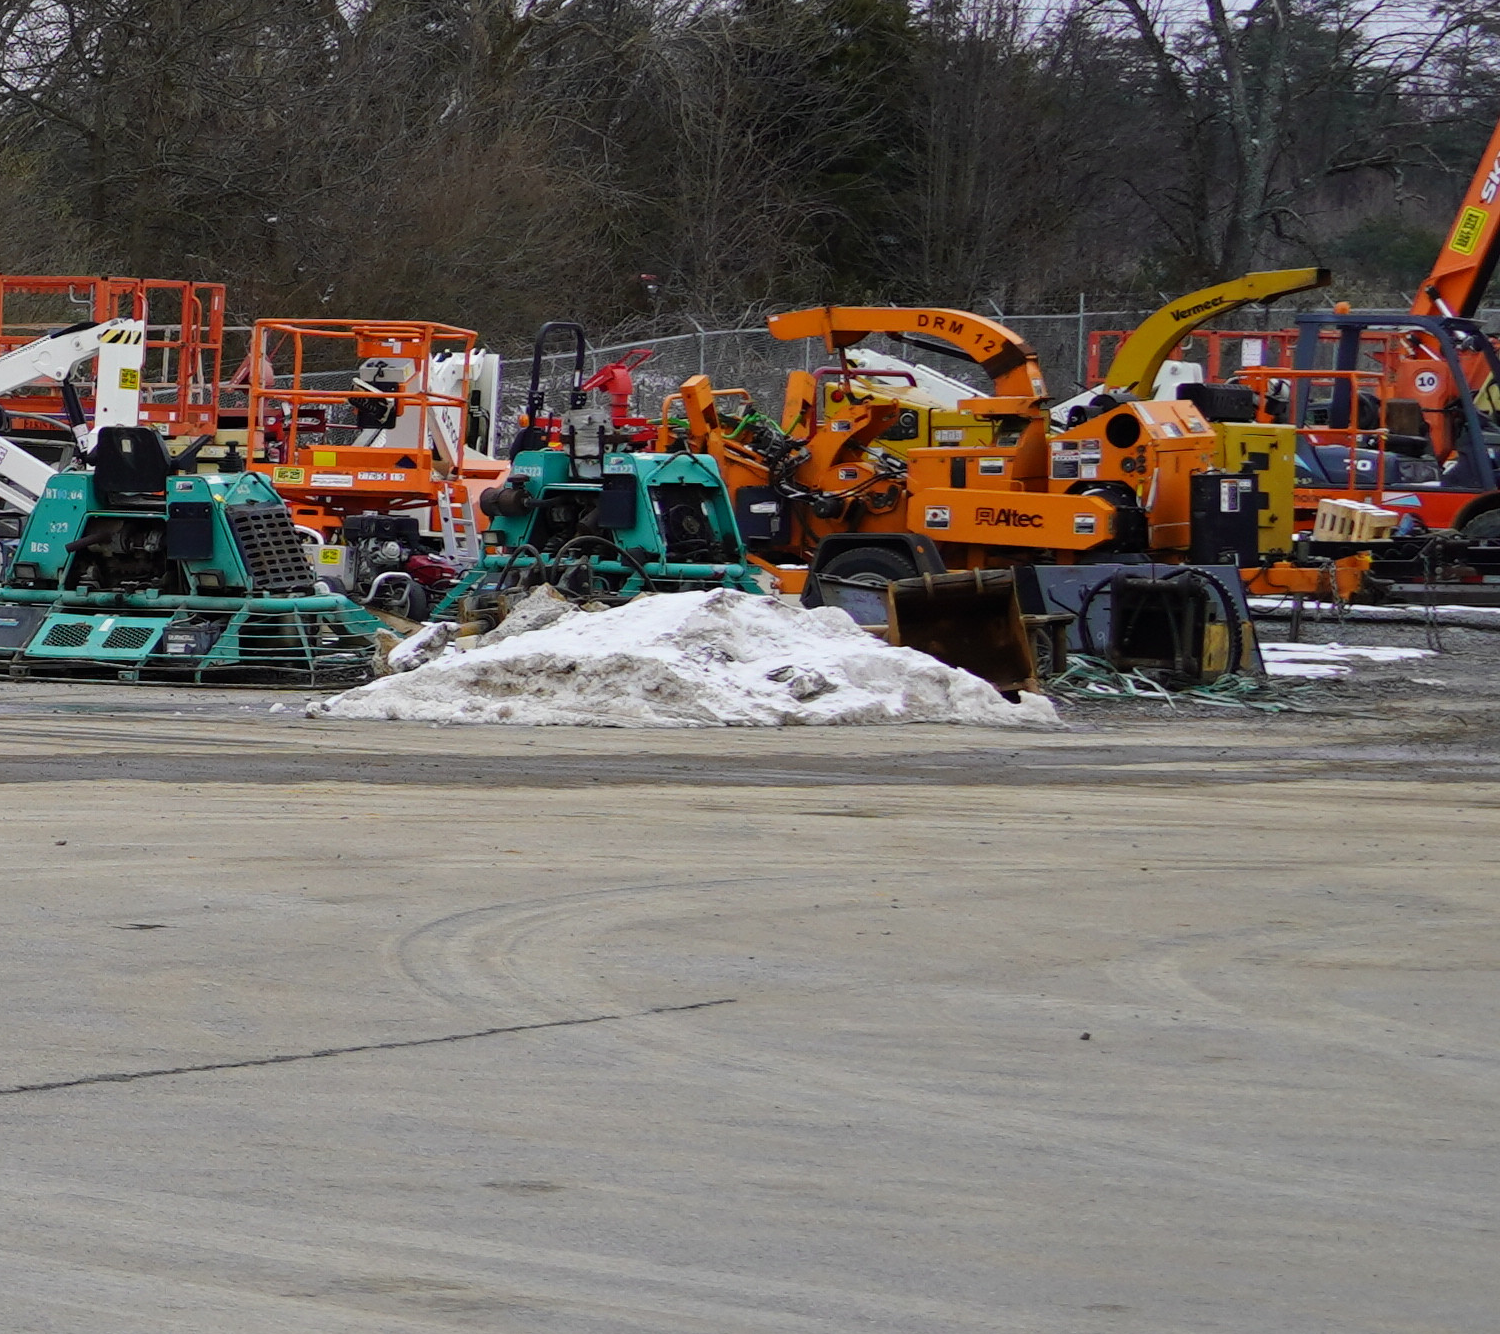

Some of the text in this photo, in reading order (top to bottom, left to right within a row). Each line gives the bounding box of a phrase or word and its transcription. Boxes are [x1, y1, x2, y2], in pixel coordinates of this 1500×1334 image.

[1170, 296, 1224, 322] Vermeer
[917, 314, 996, 353] DRM 12
[1417, 376, 1436, 387] 10
[995, 508, 1043, 528] Altec
[31, 541, 50, 553] BCS
